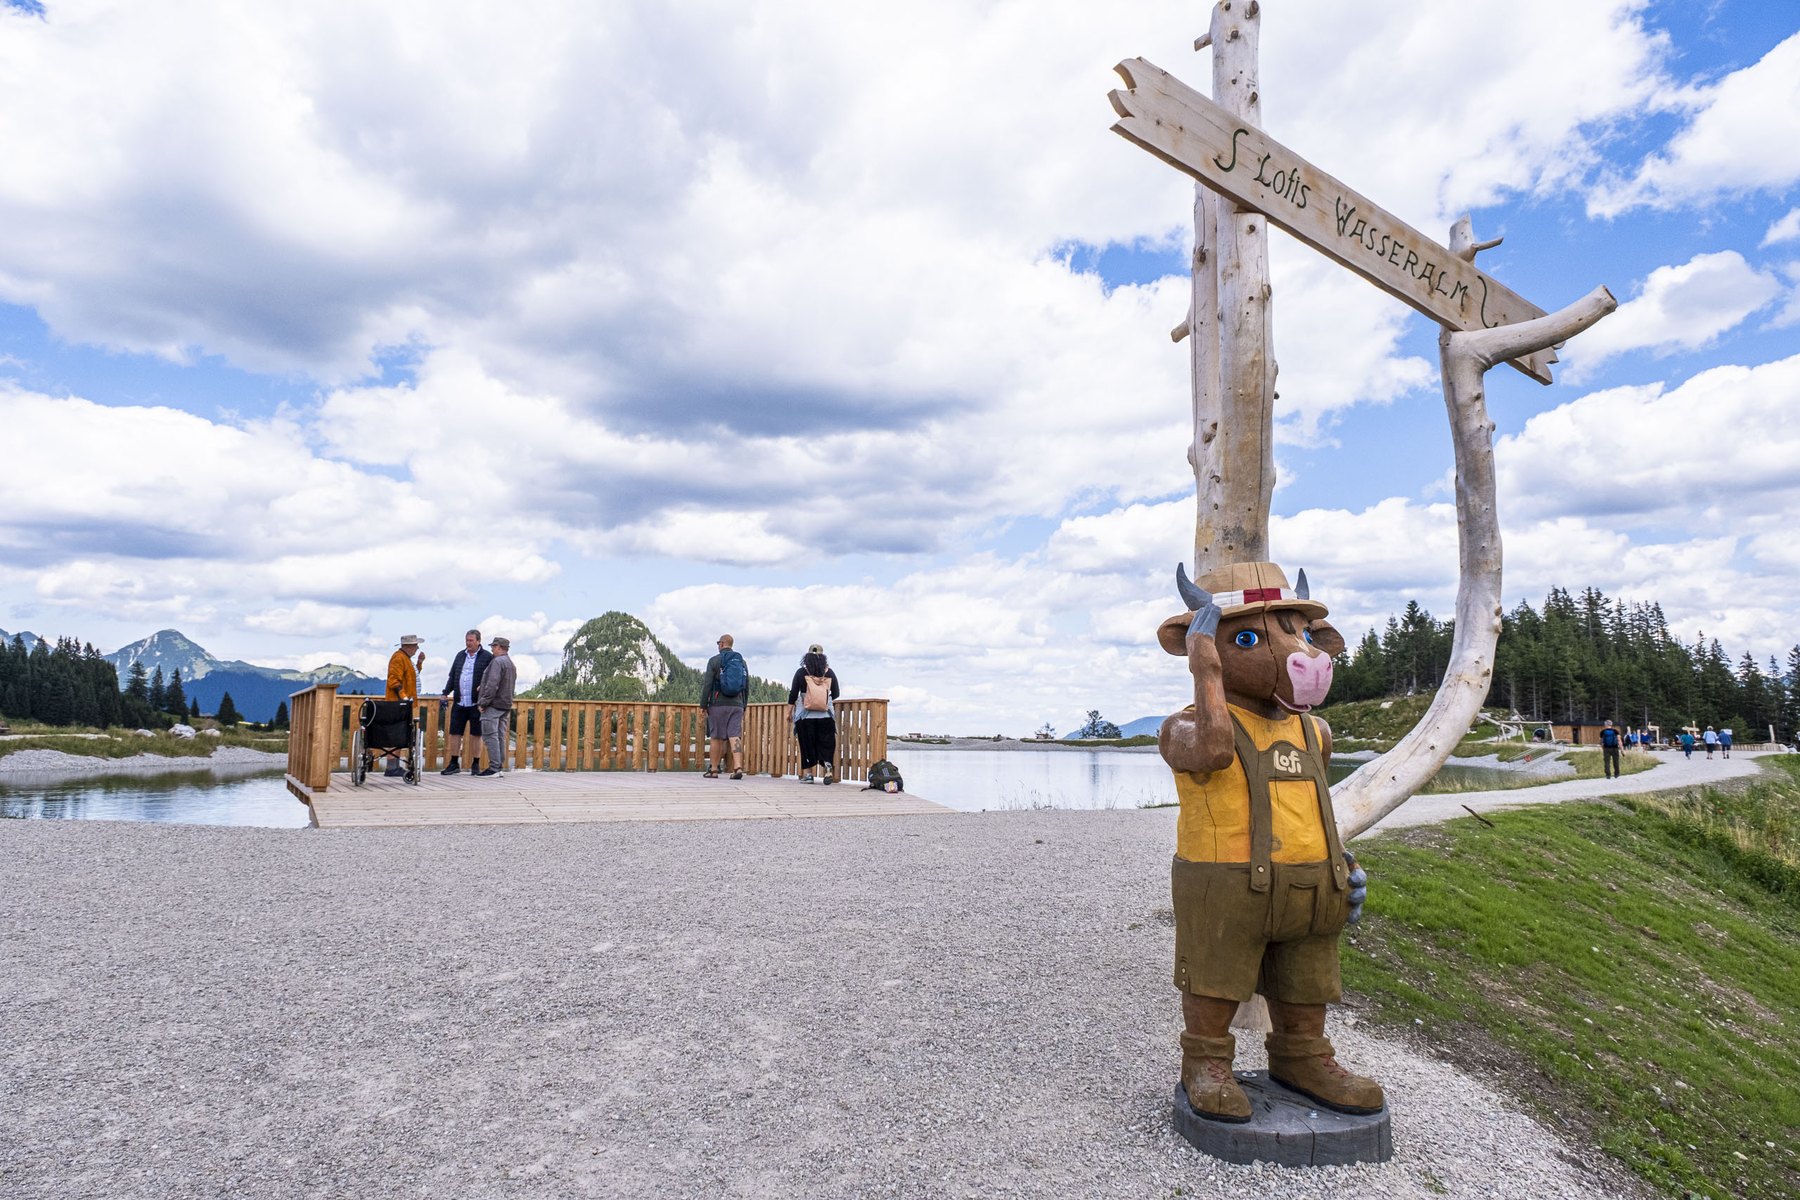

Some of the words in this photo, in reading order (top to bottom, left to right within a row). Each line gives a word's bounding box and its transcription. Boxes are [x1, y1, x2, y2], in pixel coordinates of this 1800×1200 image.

[1253, 152, 1311, 209] Lofis
[1336, 196, 1468, 310] WASSERALM
[1273, 750, 1302, 774] Lofi
